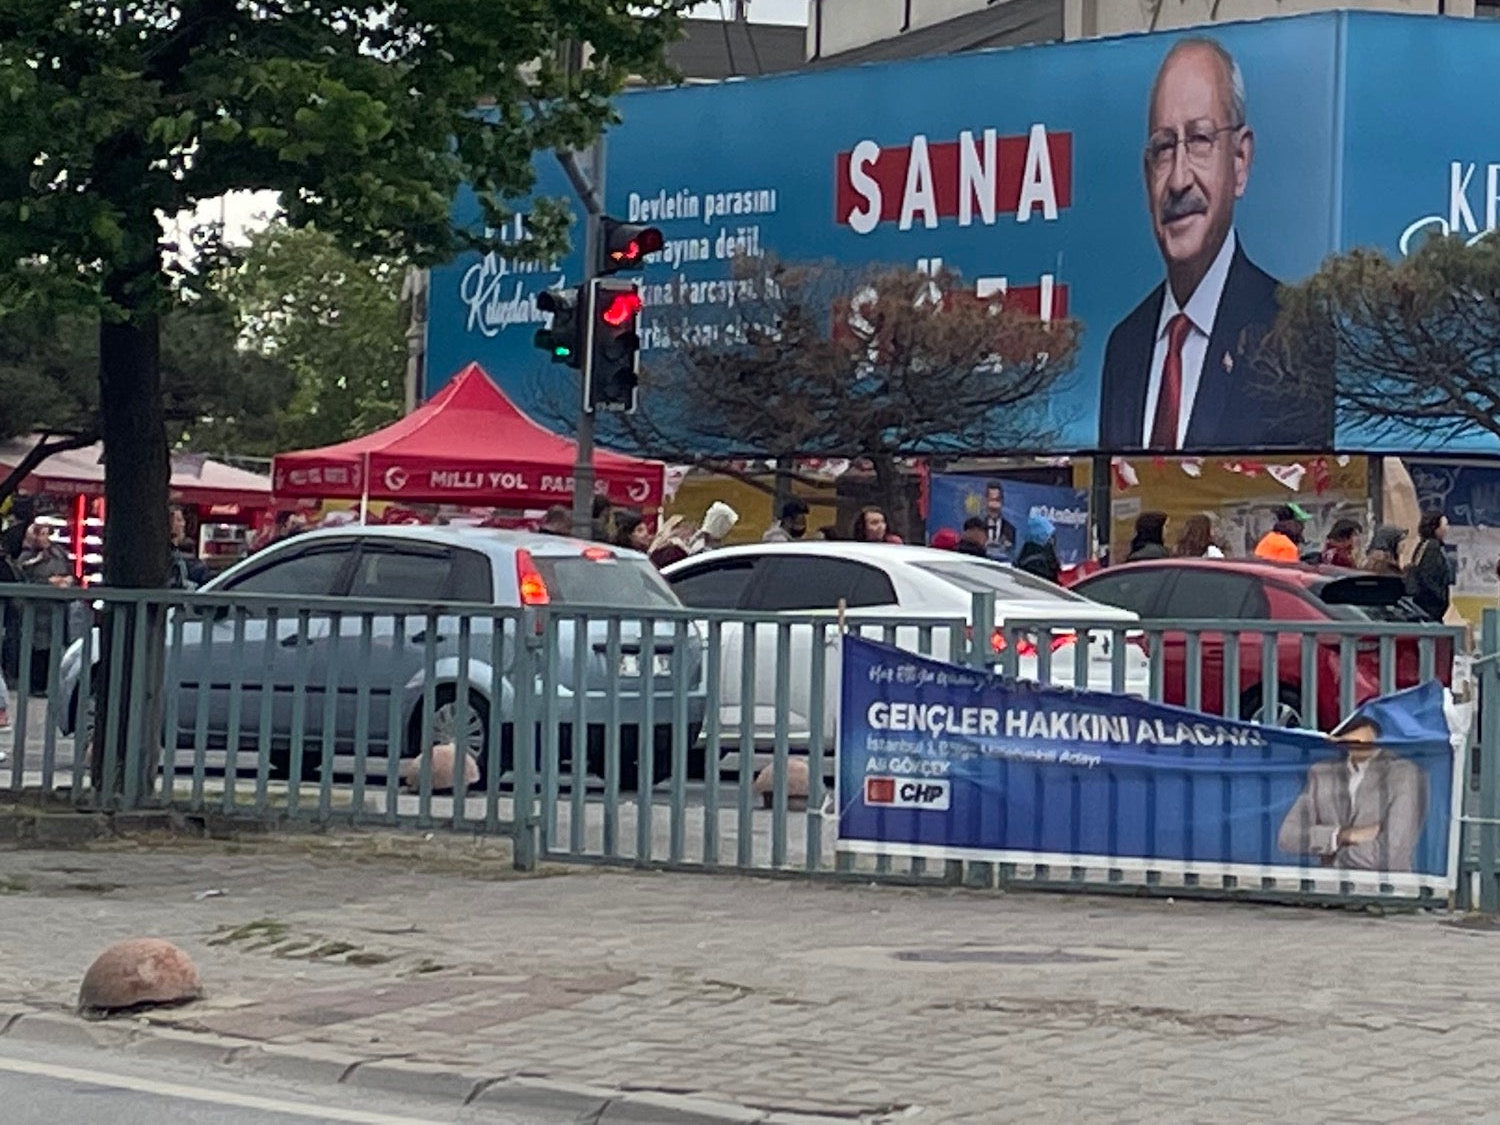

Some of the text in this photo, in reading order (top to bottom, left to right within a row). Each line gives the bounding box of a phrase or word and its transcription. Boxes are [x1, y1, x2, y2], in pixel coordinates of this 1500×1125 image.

[847, 124, 1059, 234] SANA
[628, 188, 776, 225] Devletin parasını
[489, 472, 529, 490] YOL
[866, 701, 1000, 739] GENÇLER
[1004, 708, 1131, 744] HAKKINI
[899, 783, 944, 803] CHP
